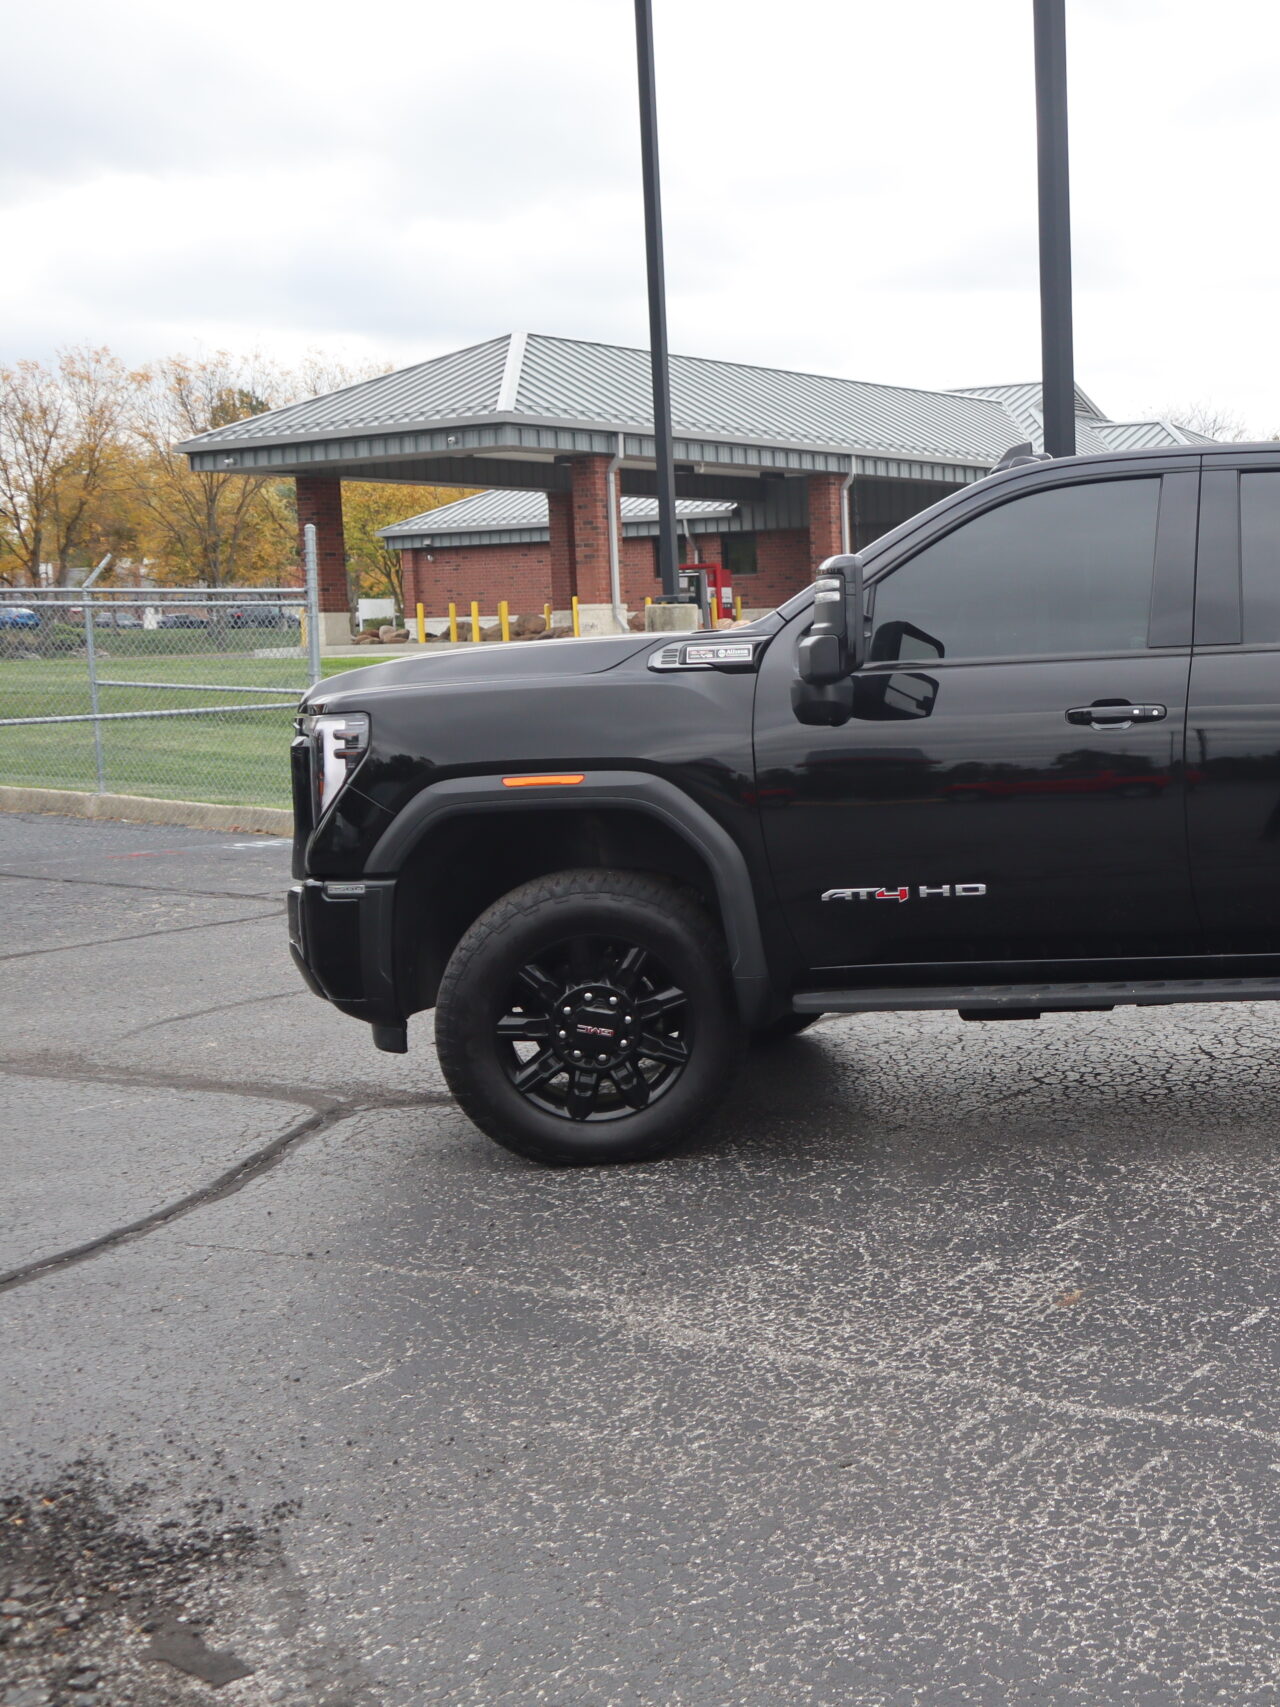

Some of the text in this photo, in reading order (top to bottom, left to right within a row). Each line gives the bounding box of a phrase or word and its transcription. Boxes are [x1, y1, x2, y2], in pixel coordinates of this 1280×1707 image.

[821, 884, 987, 903] AT4 HD
[576, 1024, 616, 1038] GMC
